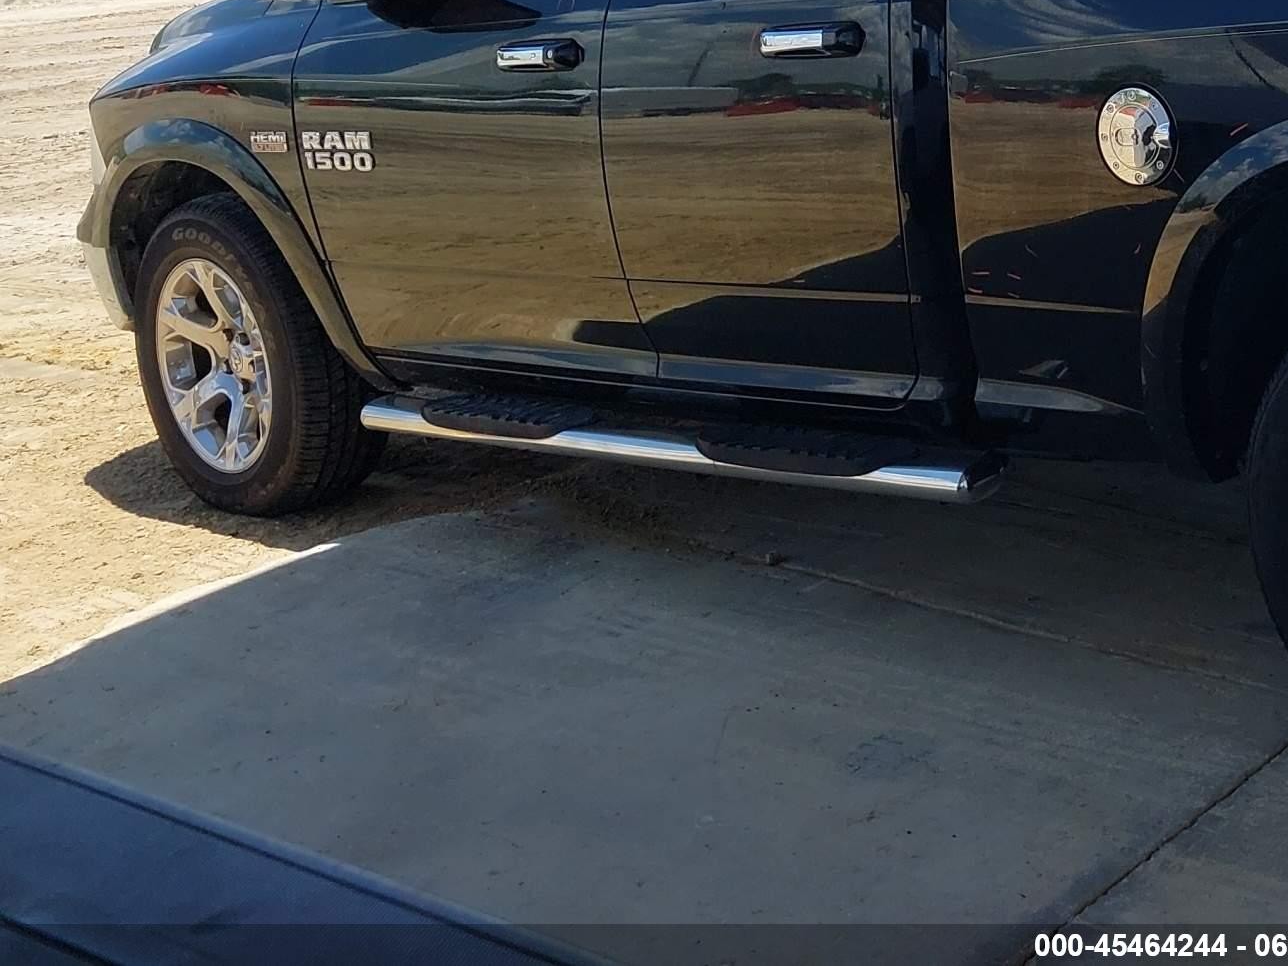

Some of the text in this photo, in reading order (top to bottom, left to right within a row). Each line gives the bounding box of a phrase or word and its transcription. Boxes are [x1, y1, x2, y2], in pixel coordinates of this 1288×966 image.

[250, 131, 286, 143] HEMI
[302, 131, 371, 150] RAM
[304, 152, 375, 171] 1500
